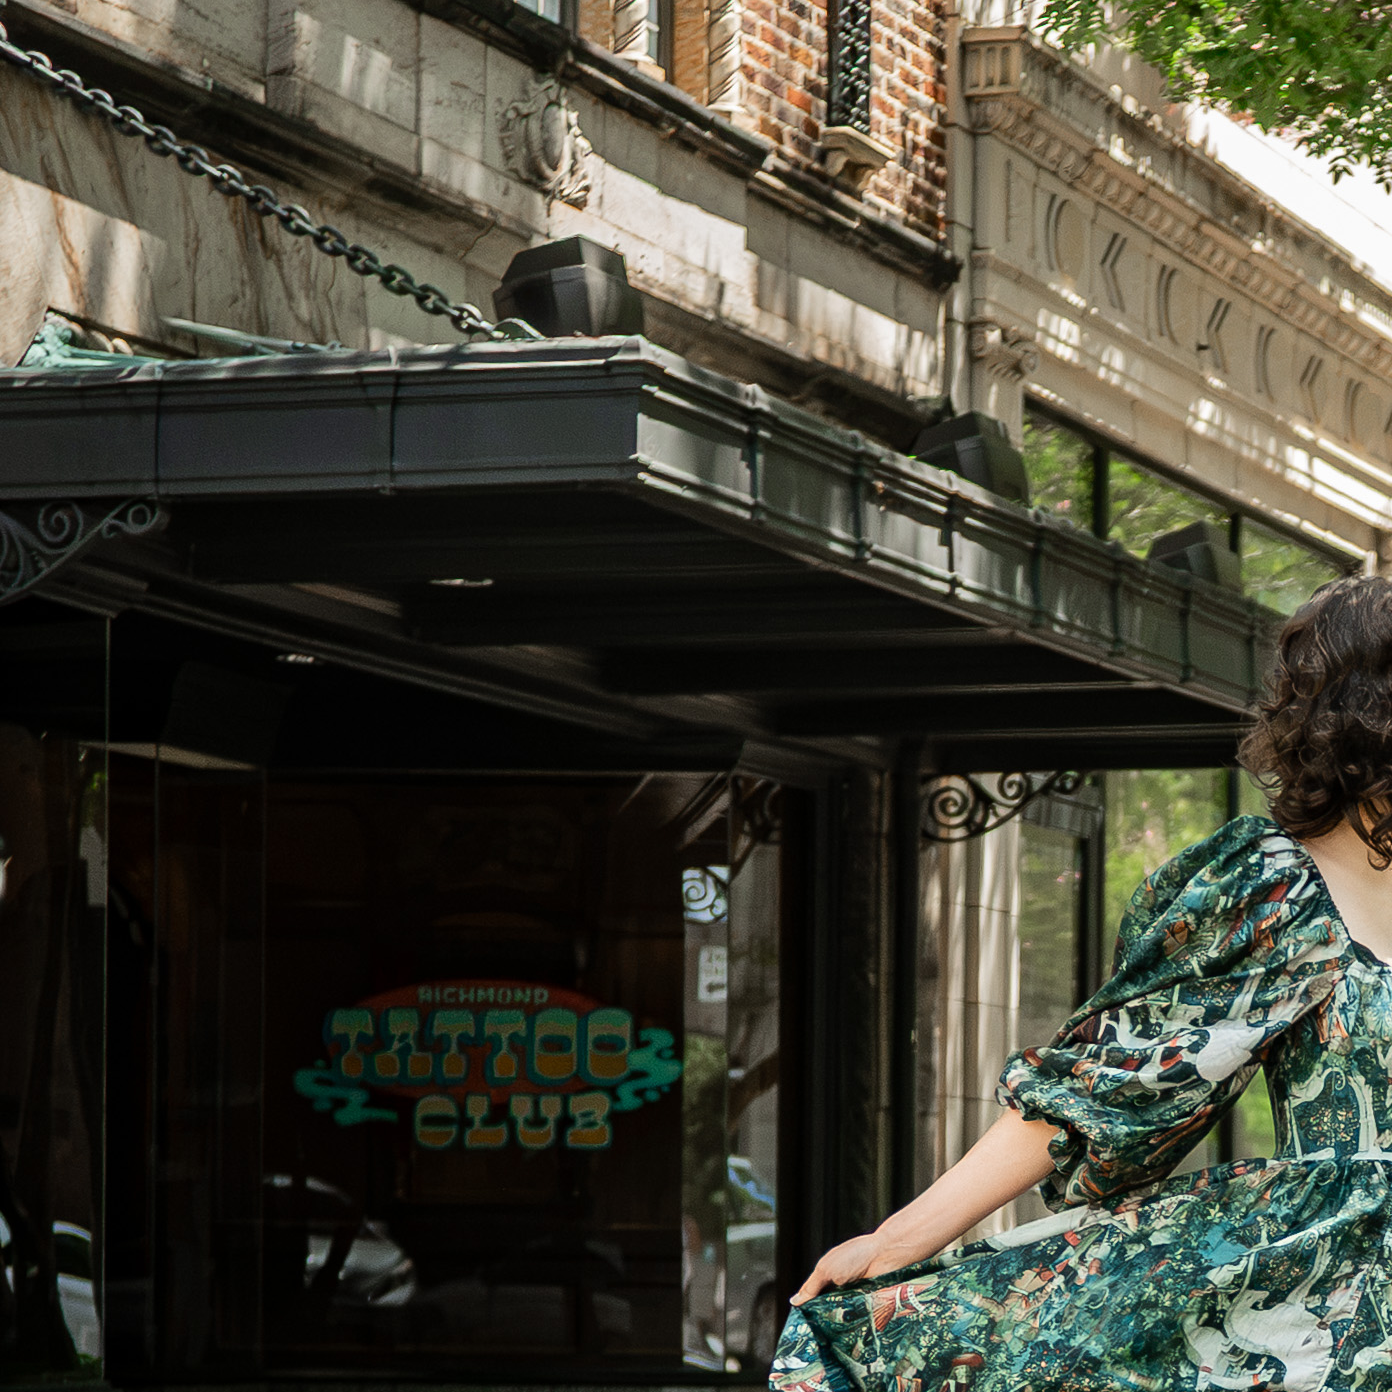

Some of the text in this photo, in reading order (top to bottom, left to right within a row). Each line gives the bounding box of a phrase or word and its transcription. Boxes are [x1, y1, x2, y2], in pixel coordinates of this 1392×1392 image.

[417, 984, 549, 1004] RICHMOND
[328, 1007, 632, 1079] TATTOO
[415, 1092, 613, 1148] CLUB
